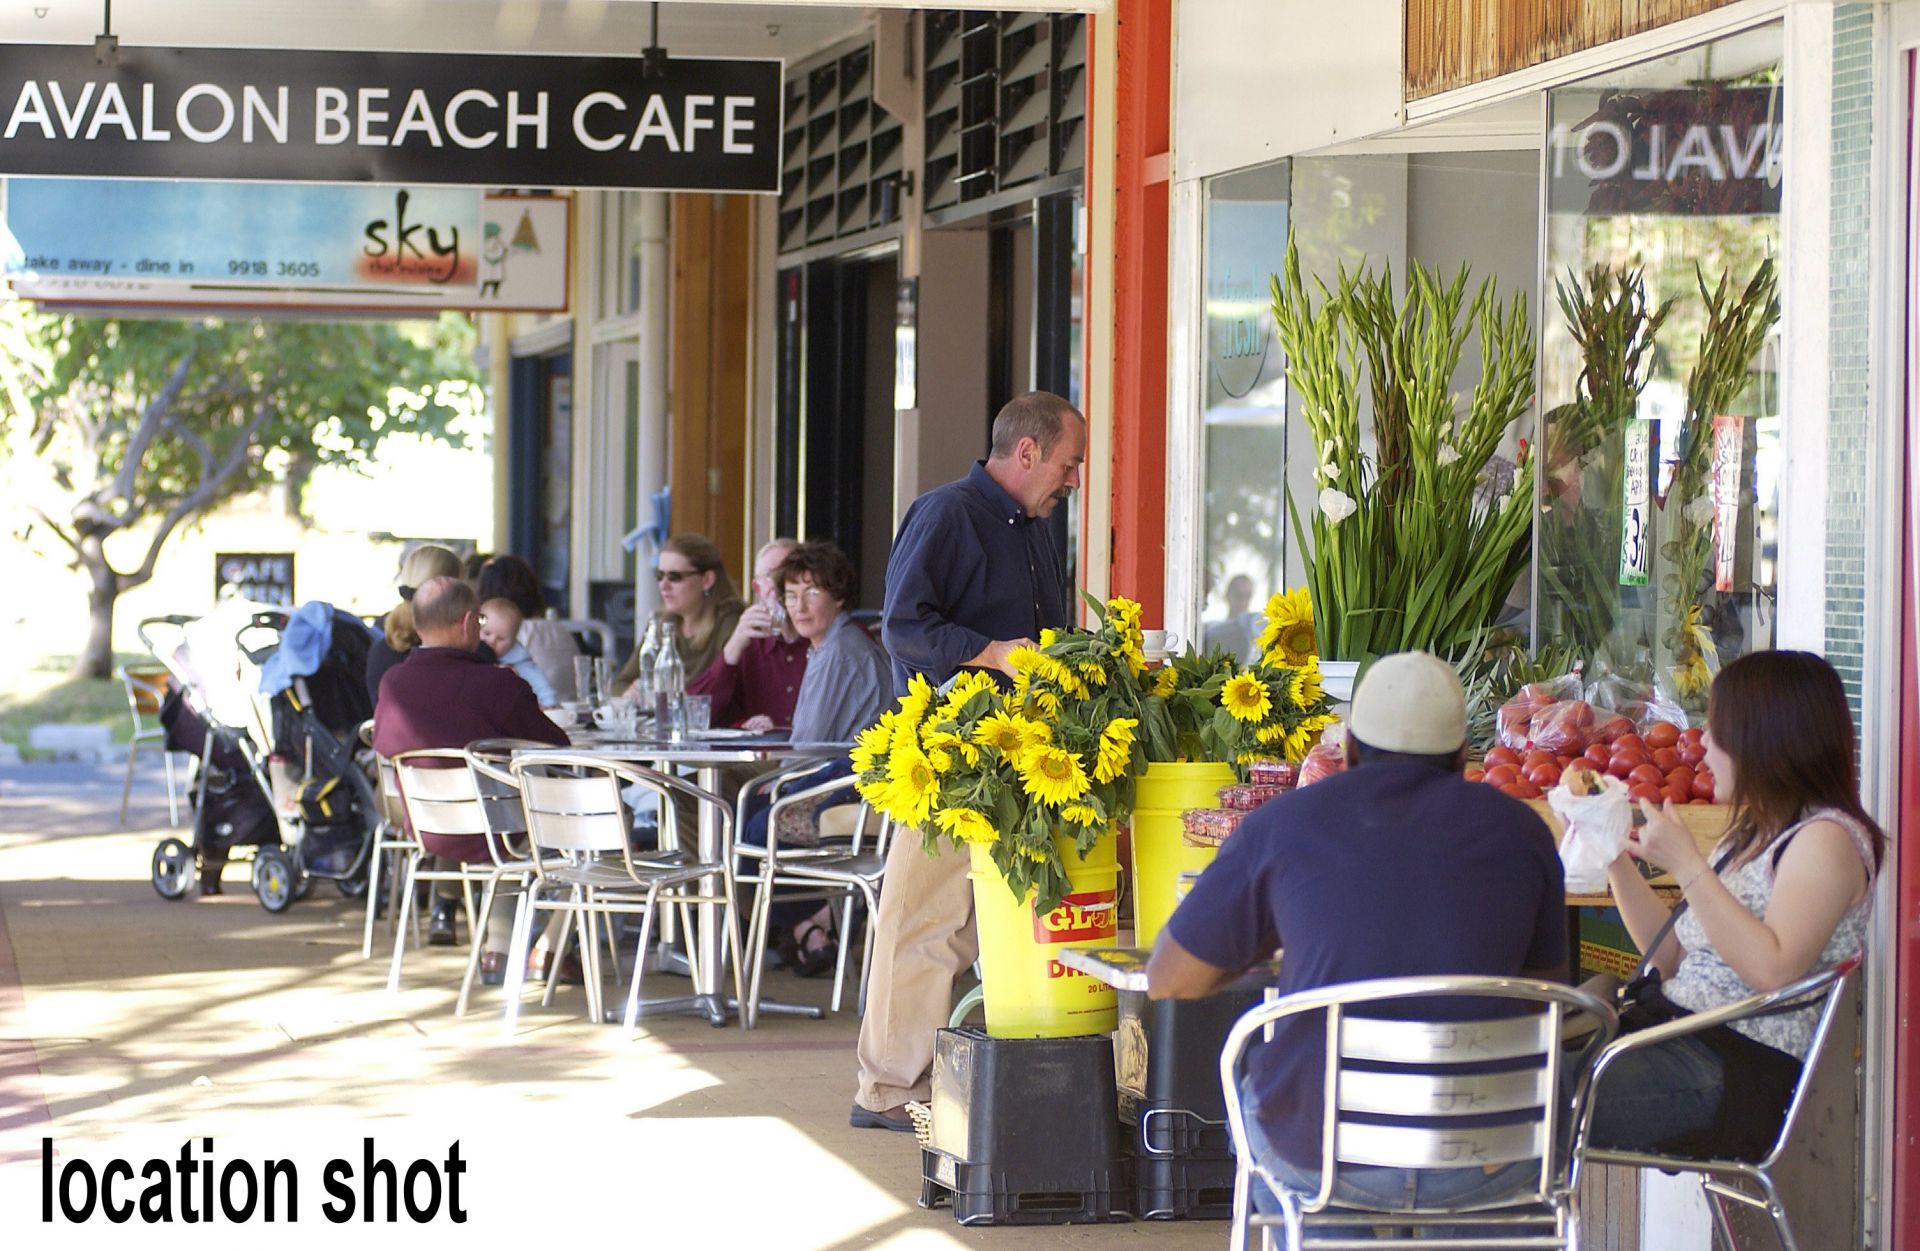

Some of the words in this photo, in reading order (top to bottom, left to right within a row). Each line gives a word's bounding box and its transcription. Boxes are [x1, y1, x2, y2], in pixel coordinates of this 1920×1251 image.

[3, 80, 289, 144] AVALON
[315, 87, 548, 149] BEACH
[572, 91, 755, 154] CAFE
[364, 188, 459, 284] sky
[68, 260, 112, 274] away
[136, 257, 170, 273] dine
[179, 258, 194, 273] in
[228, 260, 267, 275] 9918
[276, 261, 319, 277] 3605
[222, 559, 287, 582] CAFE
[242, 584, 292, 606] PEN
[1088, 984, 1097, 993] 20
